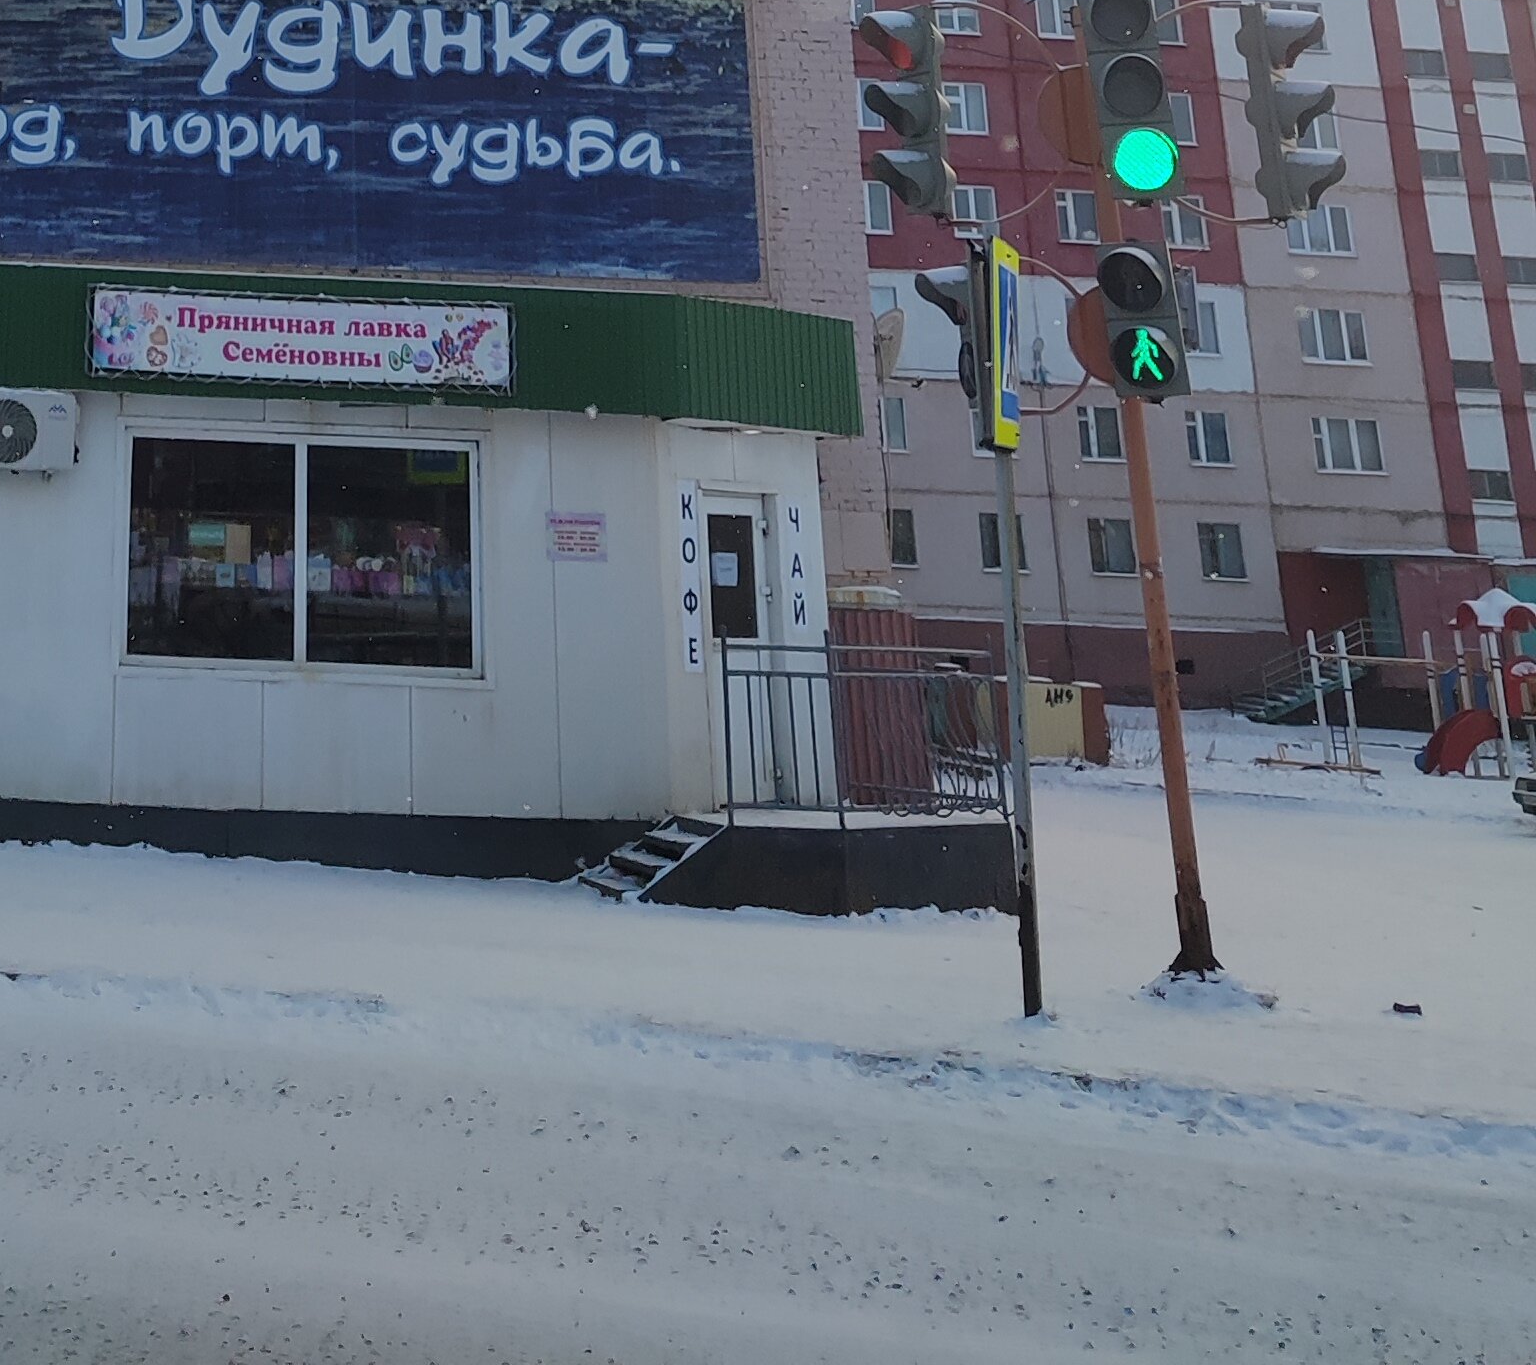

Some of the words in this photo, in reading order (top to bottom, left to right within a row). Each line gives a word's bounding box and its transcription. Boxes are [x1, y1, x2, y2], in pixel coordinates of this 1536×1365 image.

[128, 107, 342, 175] порт,
[177, 306, 337, 337] Пряничная
[344, 317, 428, 340] лавка
[222, 341, 382, 369] Семёновны
